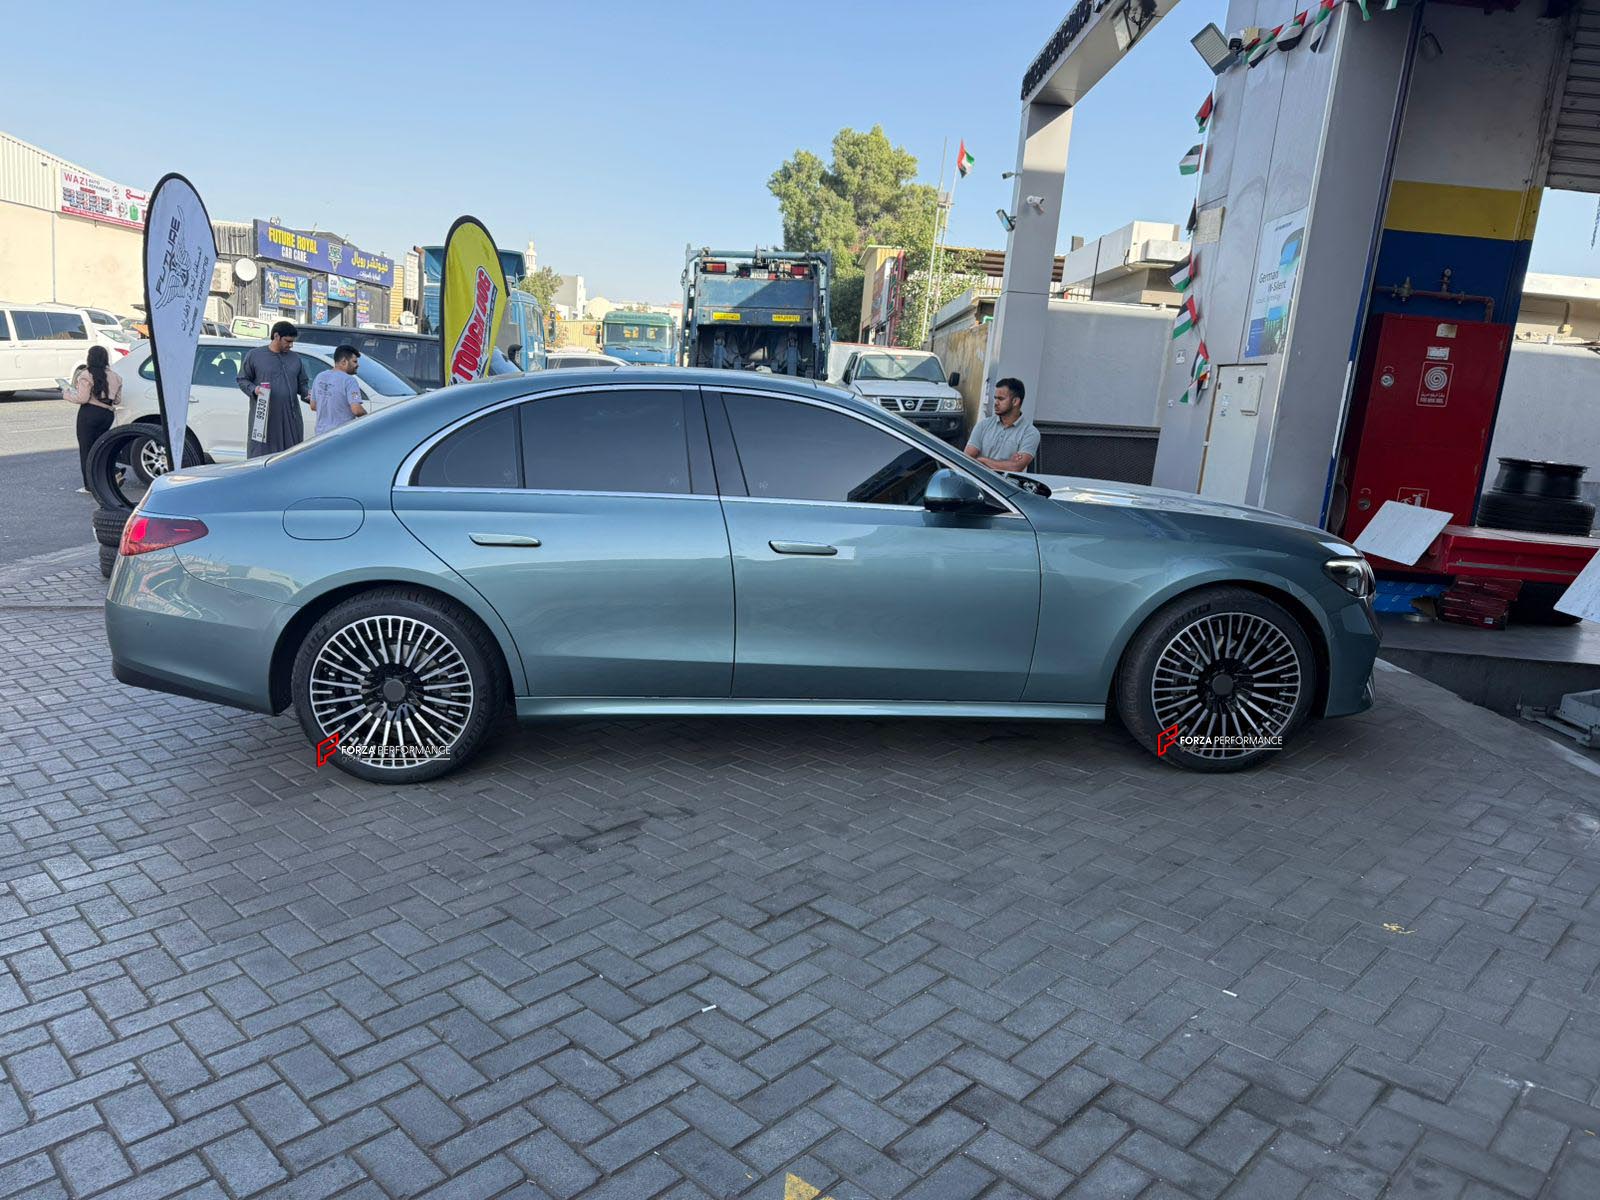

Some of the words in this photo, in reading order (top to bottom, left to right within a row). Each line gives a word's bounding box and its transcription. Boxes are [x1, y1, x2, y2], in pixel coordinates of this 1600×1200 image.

[64, 172, 88, 186] WAZI
[268, 226, 296, 248] FUTURE
[296, 234, 318, 255] ROYAL
[156, 216, 180, 295] FUTURE
[281, 246, 293, 259] CAR
[1258, 270, 1279, 284] German
